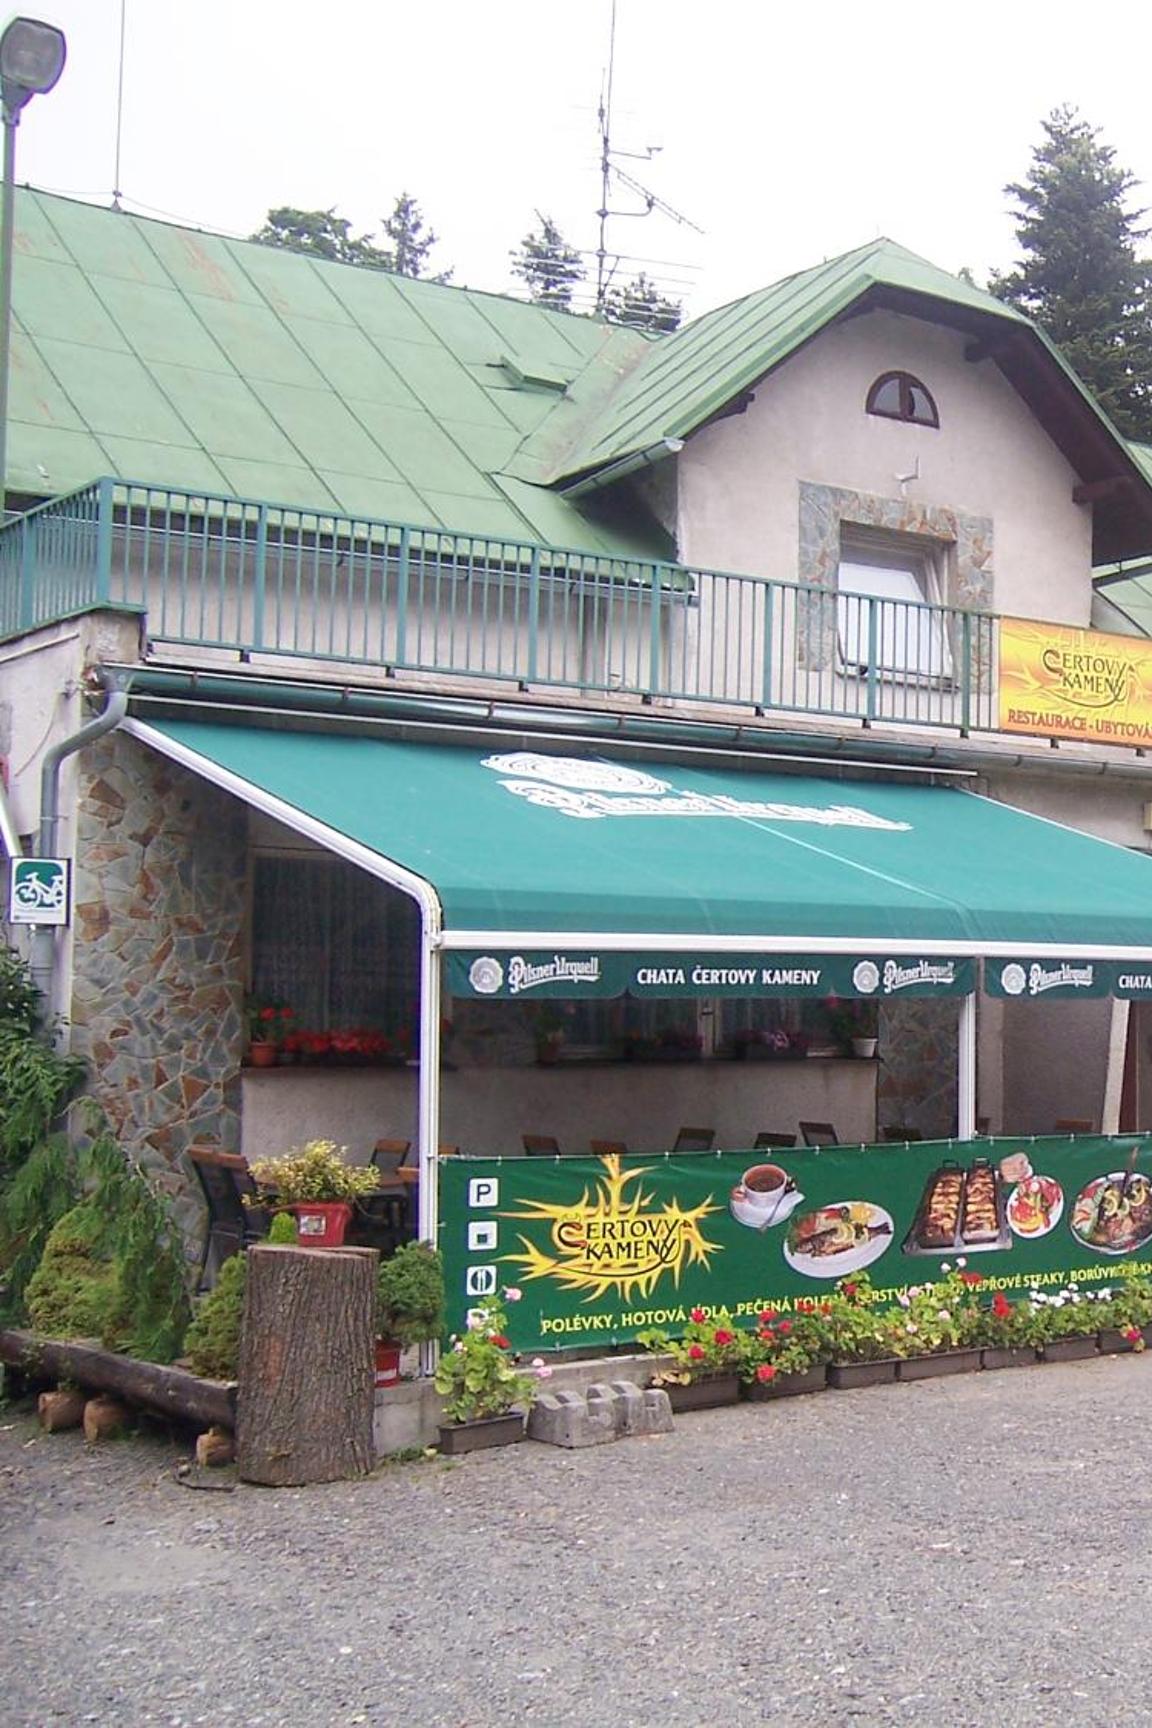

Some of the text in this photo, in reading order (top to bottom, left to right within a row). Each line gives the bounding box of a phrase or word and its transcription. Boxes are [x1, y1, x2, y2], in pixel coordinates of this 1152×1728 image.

[1063, 672, 1126, 700] KAMENY
[1008, 709, 1087, 731] RESTAURACE
[508, 955, 601, 994] Pilsner Urquell
[636, 965, 821, 986] CHATA ČERTOVY KAMENY
[1118, 974, 1152, 989] CHATA
[585, 1239, 679, 1263] KAMENY
[541, 1314, 618, 1334] POLÉVKY,
[622, 1305, 686, 1326] HOTOVÁ
[737, 1295, 791, 1317] PEČENÁ
[1023, 1271, 1068, 1288] STEAKY,
